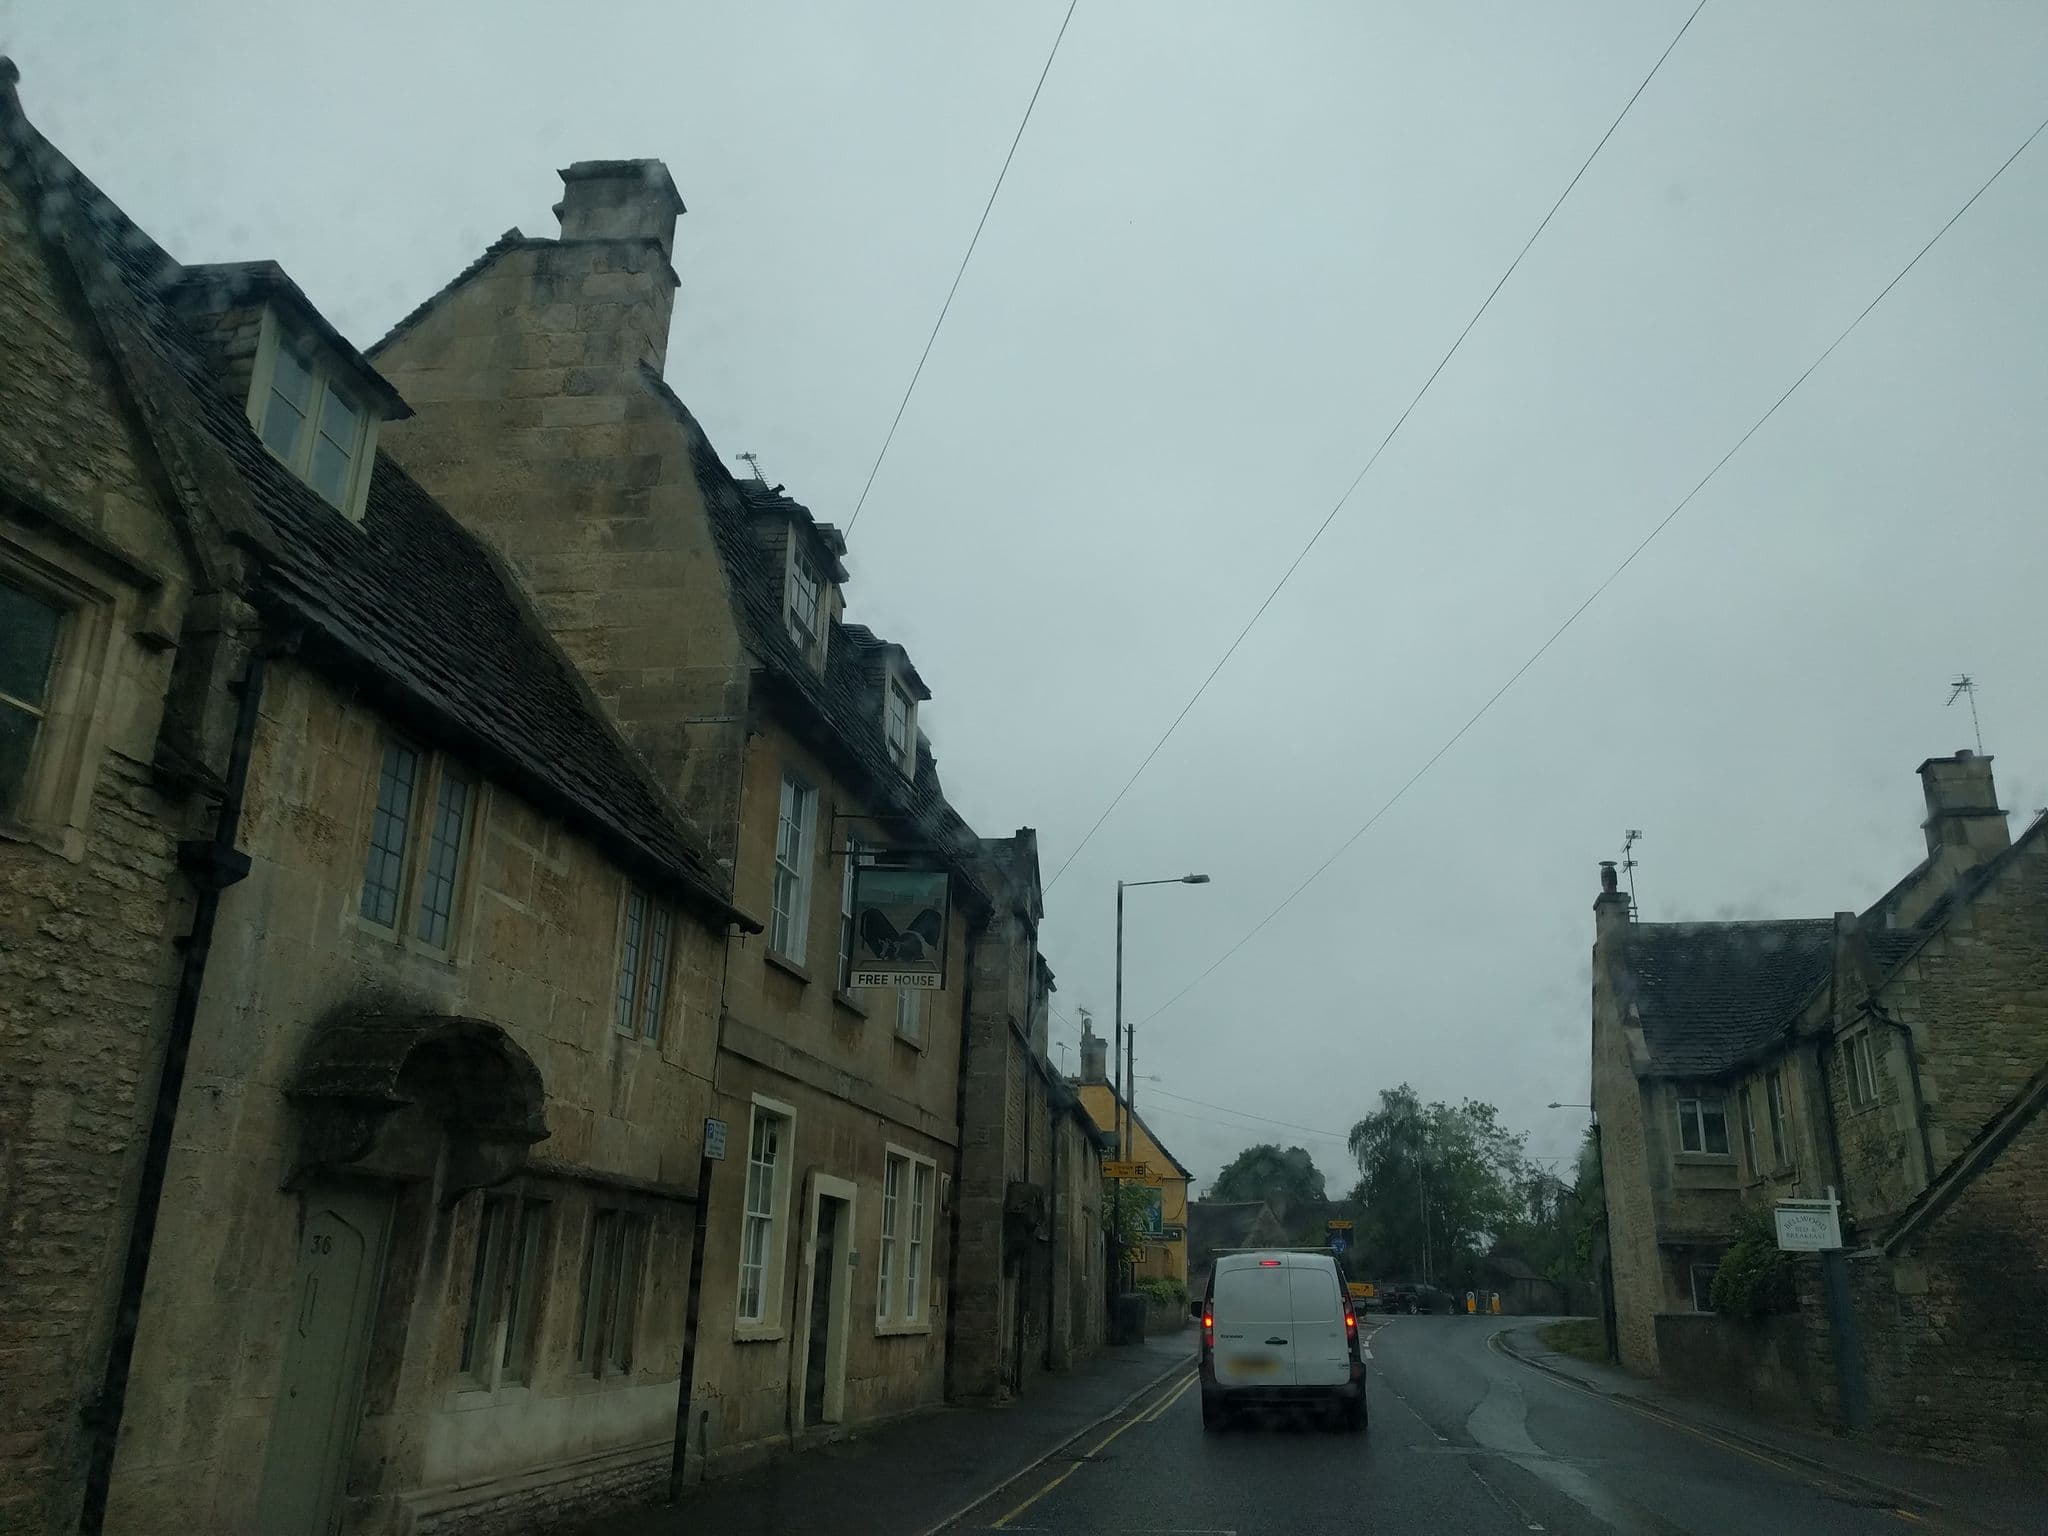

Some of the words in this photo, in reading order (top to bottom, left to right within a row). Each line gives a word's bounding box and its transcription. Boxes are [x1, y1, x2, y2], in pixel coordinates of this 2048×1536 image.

[858, 974, 889, 985] FREE
[894, 975, 935, 986] HOUSE
[1783, 1215, 1827, 1231] BELLWOOD
